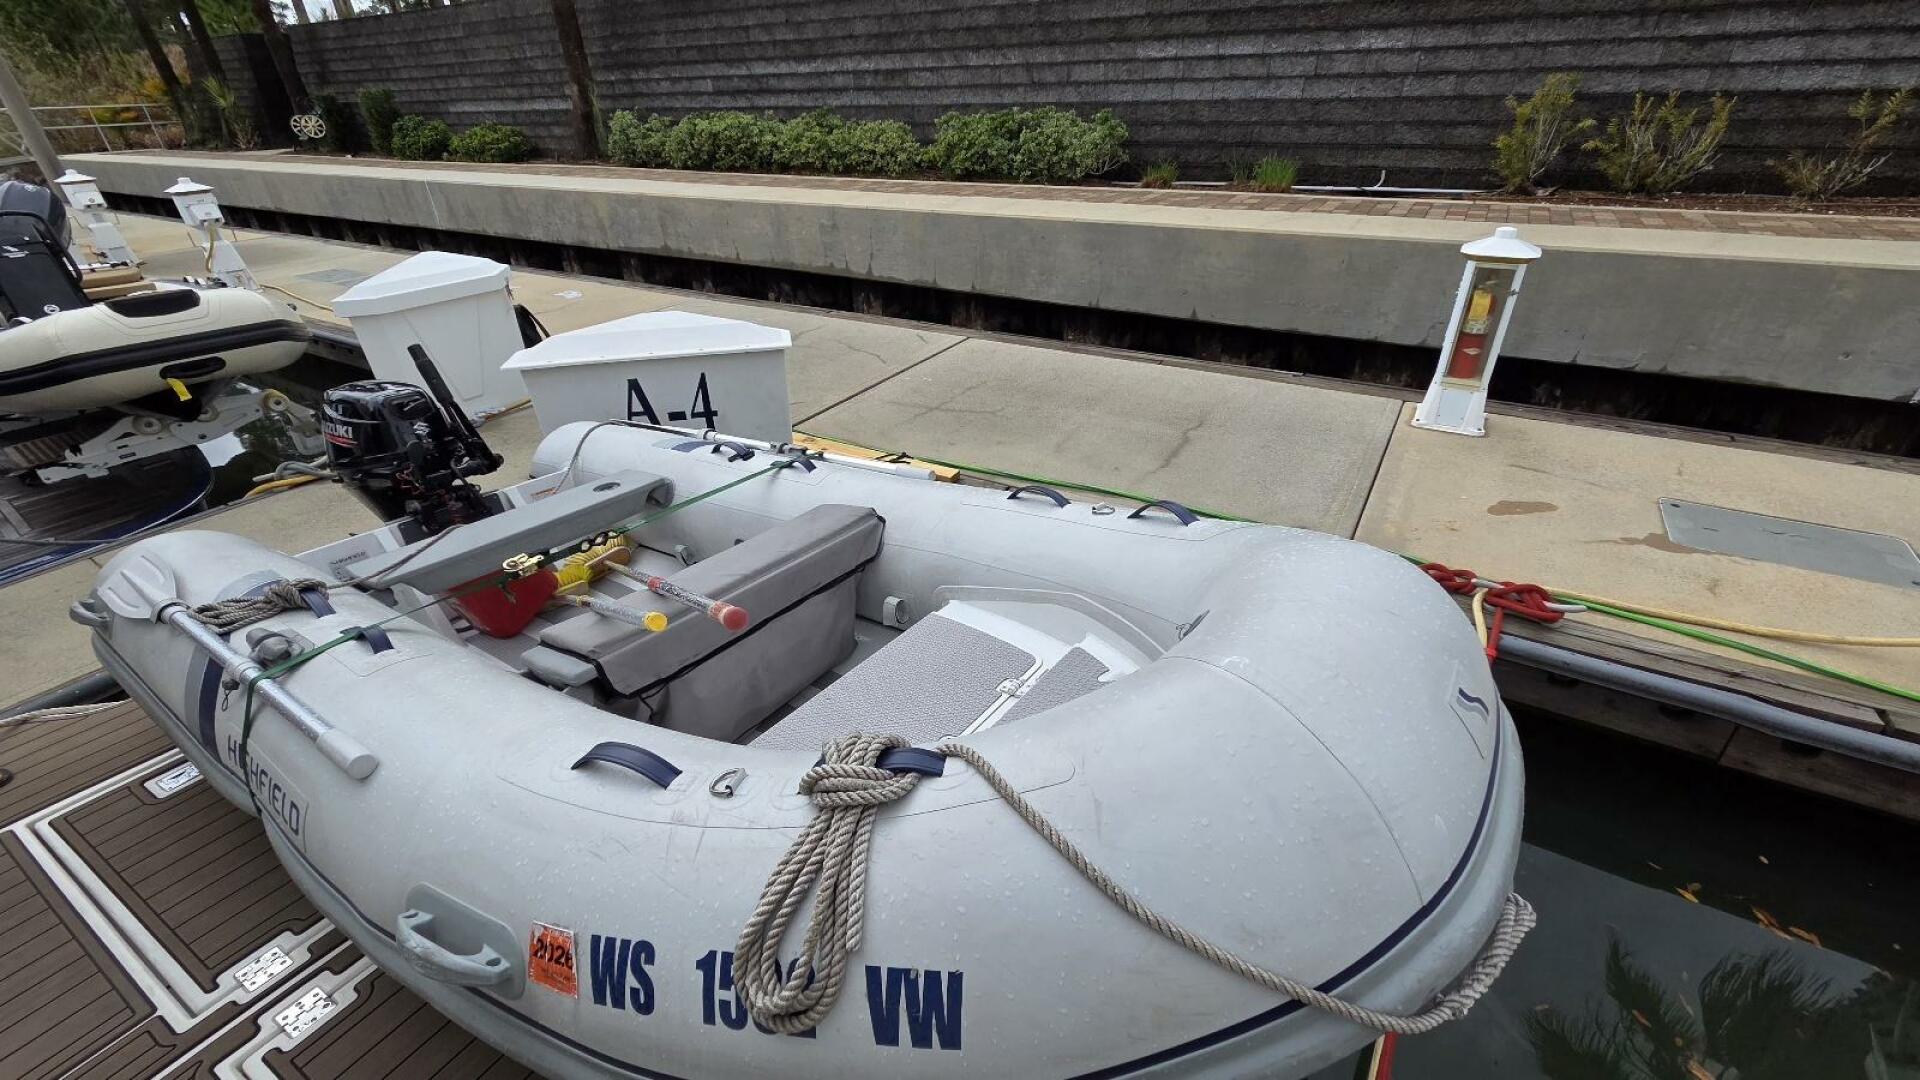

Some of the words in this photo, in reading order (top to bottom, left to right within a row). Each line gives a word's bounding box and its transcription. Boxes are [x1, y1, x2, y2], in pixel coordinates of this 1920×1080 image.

[627, 372, 718, 430] A-4
[590, 934, 655, 1015] WS
[865, 965, 964, 1050] VW
